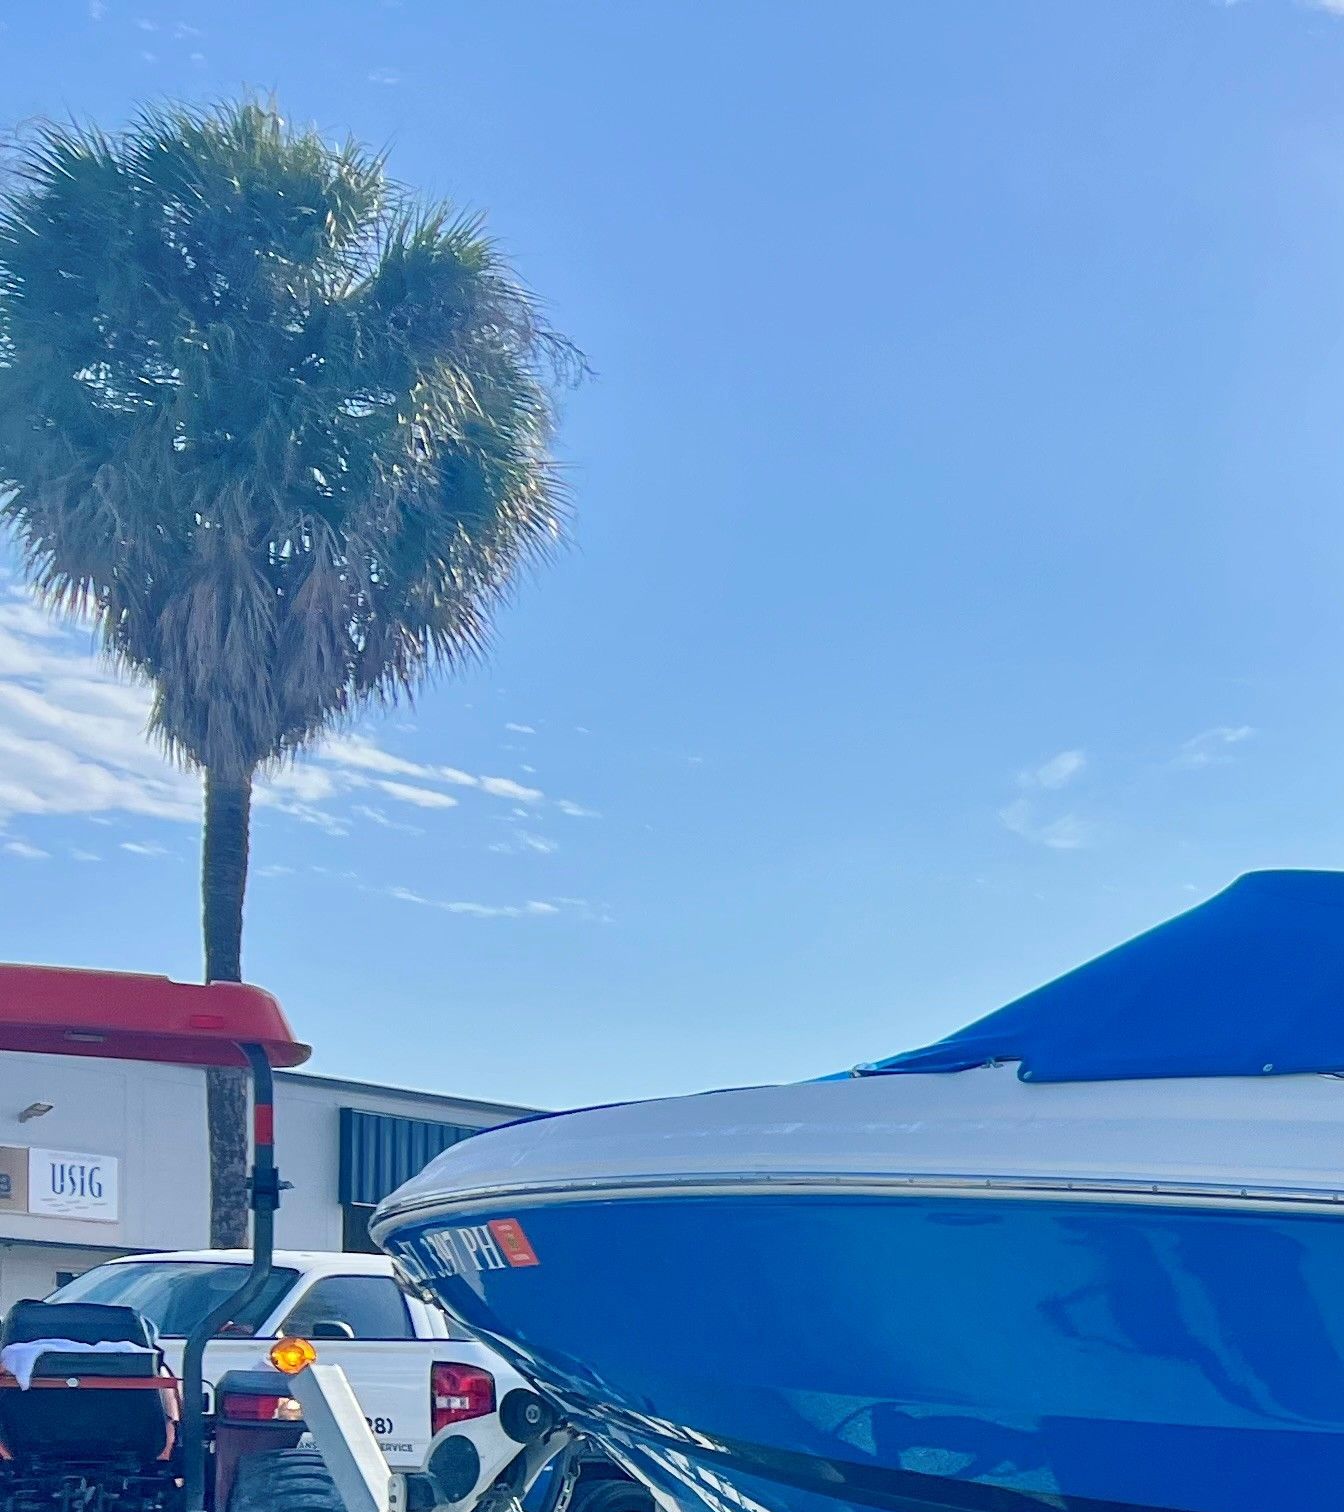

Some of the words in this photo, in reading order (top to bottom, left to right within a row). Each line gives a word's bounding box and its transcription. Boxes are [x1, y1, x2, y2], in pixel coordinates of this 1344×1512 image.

[50, 1163, 102, 1198] USIG
[456, 1225, 506, 1270] PH
[379, 1443, 413, 1452] ERVICE
